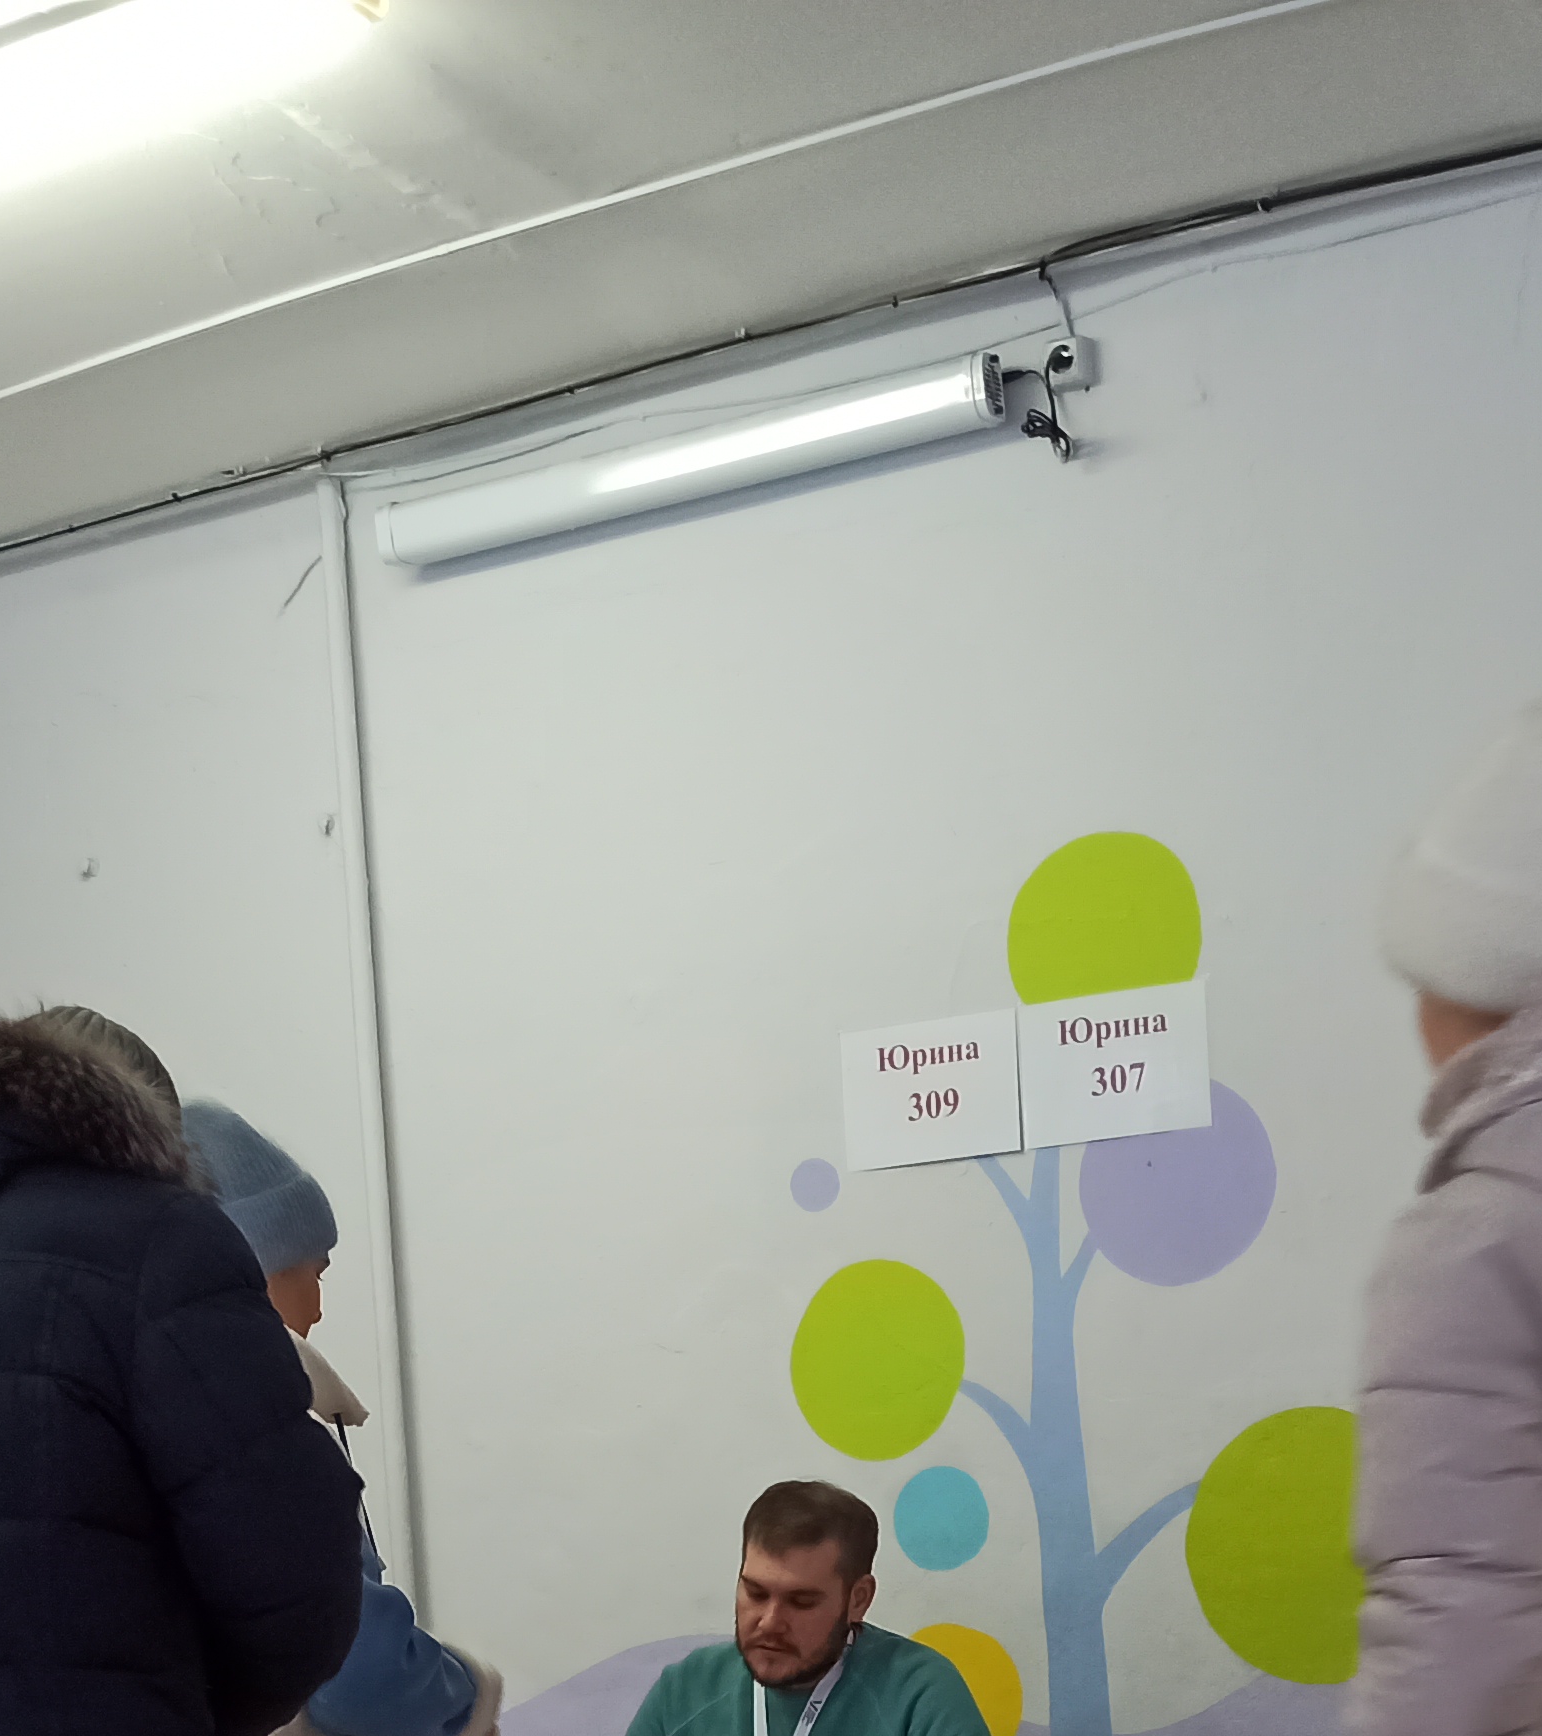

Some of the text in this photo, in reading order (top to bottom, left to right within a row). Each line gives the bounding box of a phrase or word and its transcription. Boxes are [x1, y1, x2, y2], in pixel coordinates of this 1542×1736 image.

[1058, 1013, 1168, 1049] Юрина
[877, 1041, 980, 1075] Юрина
[1091, 1061, 1146, 1097] 307
[908, 1087, 960, 1122] 309
